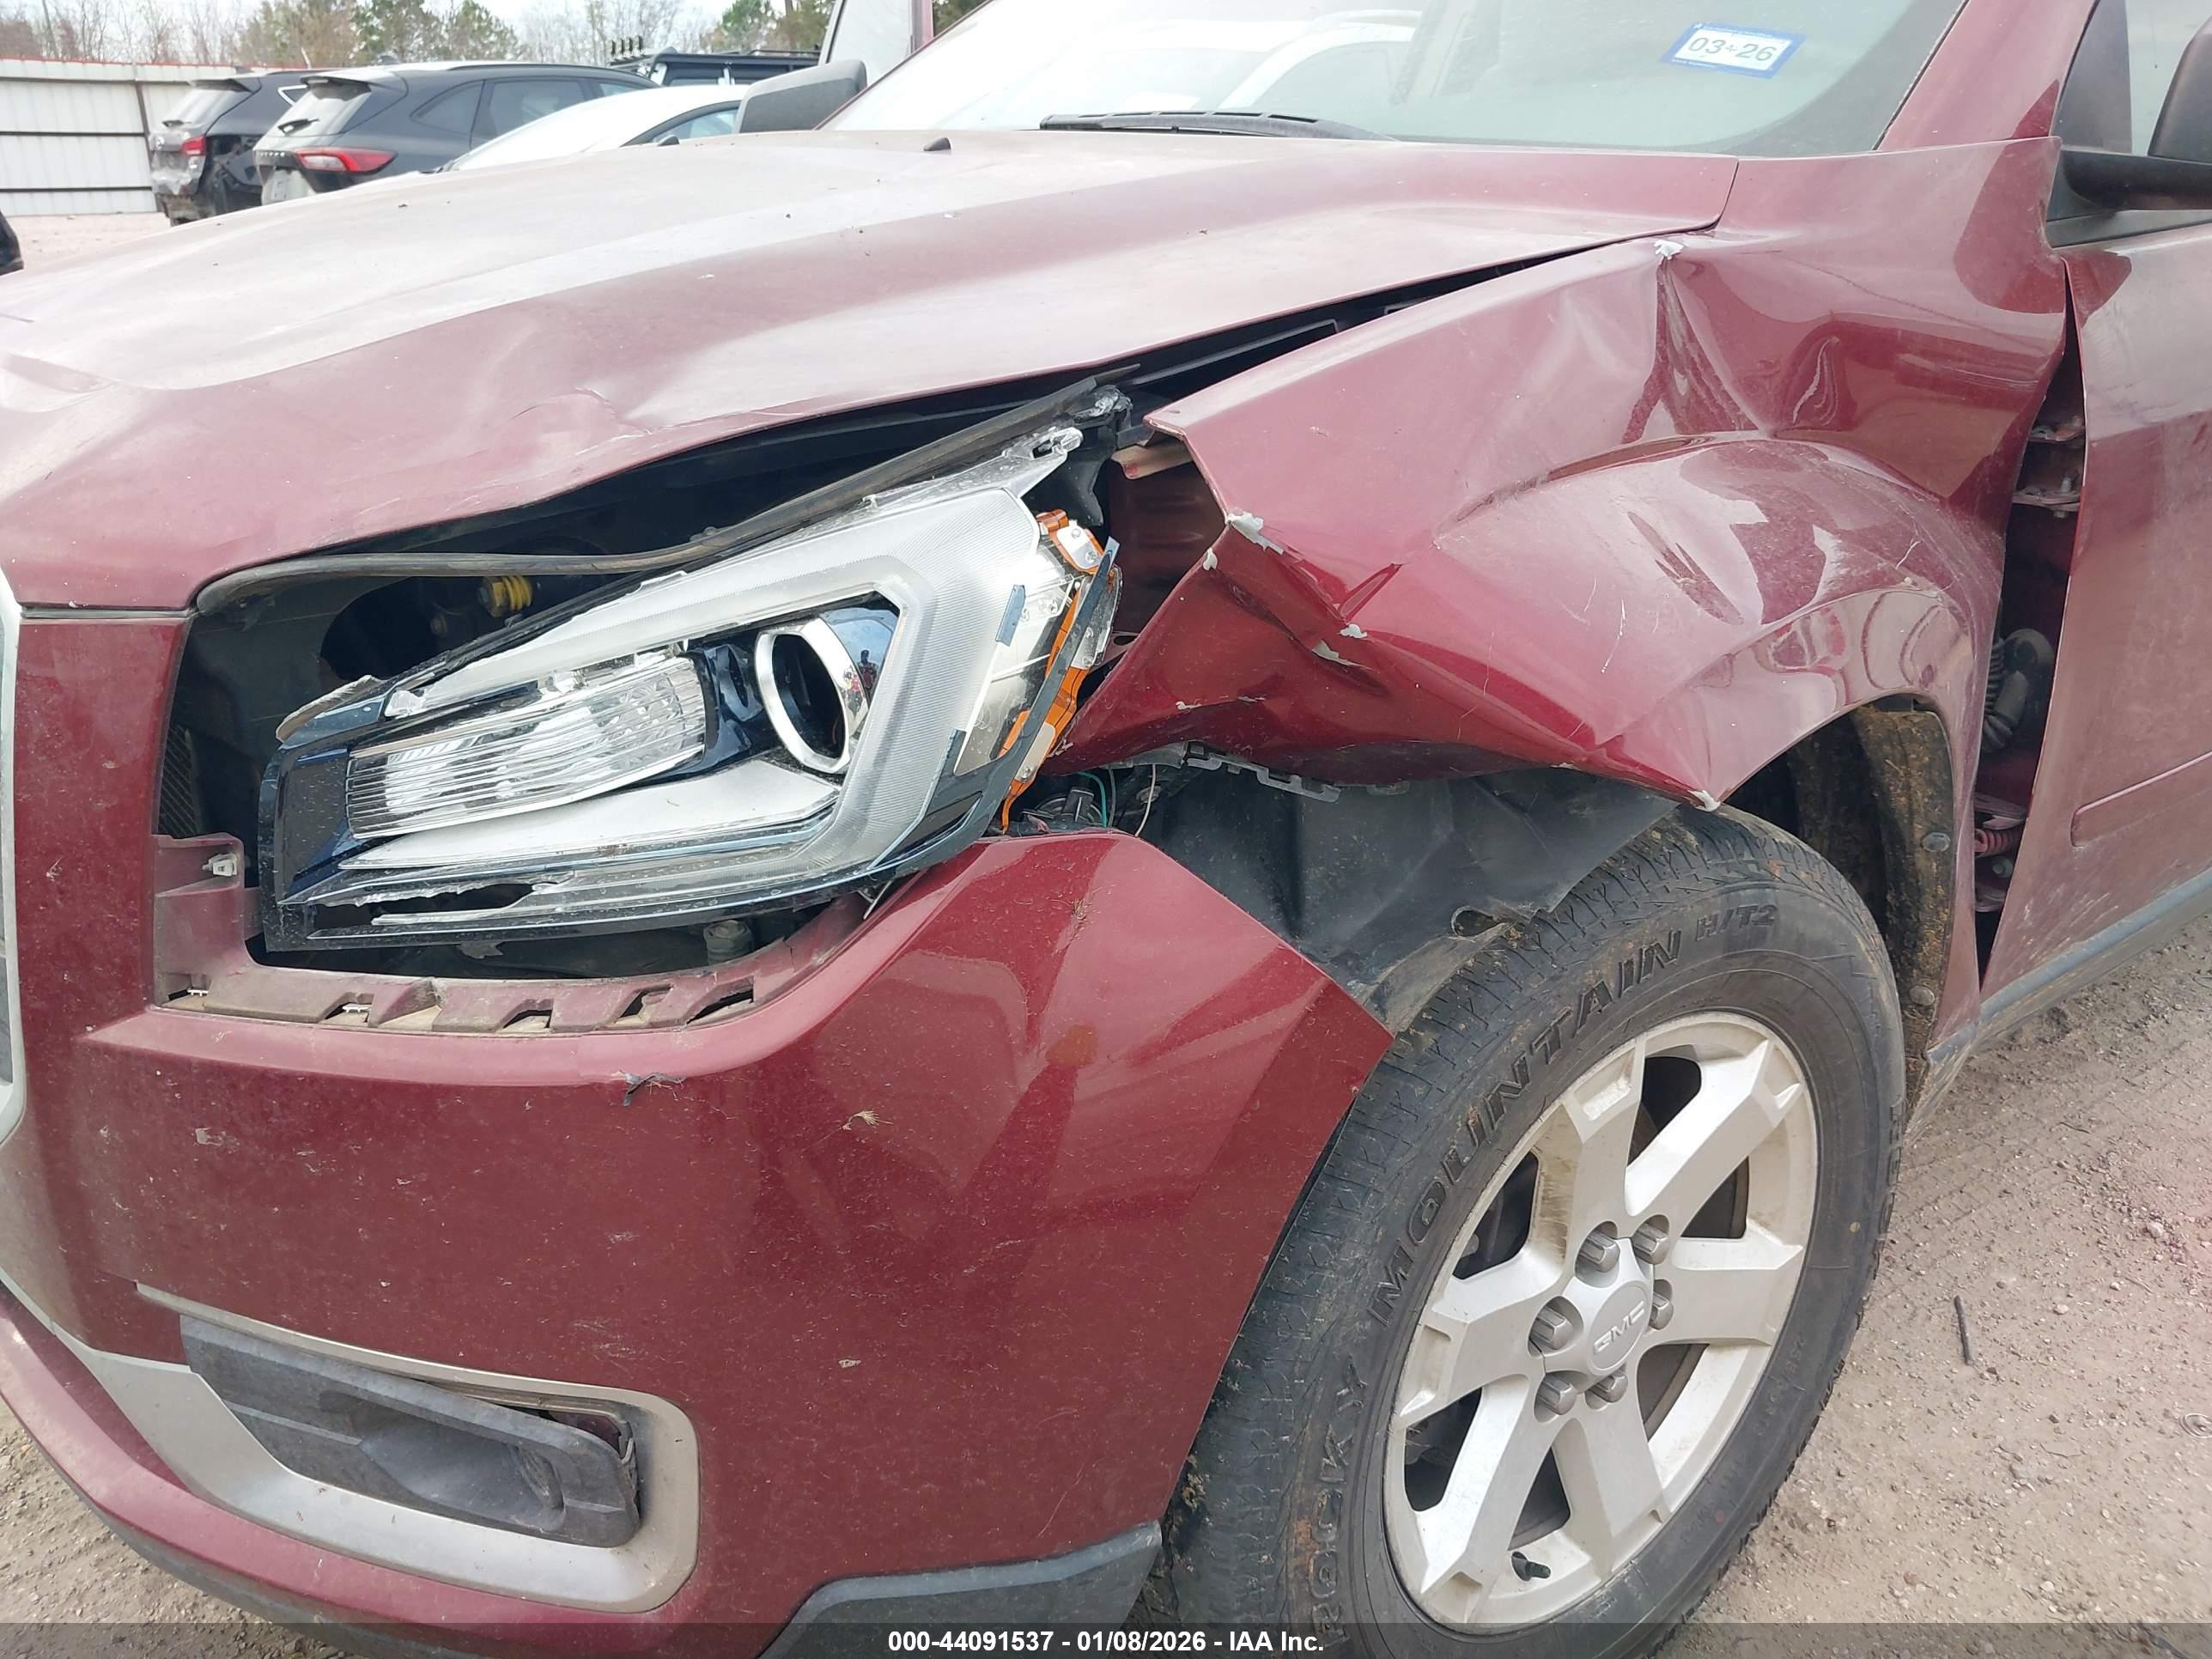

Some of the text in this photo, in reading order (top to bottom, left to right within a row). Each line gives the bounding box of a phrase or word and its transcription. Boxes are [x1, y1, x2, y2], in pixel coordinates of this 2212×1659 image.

[1310, 904, 1779, 1647] ROCKY MOUNTAIN H/T2
[1594, 1300, 1645, 1354] GMC
